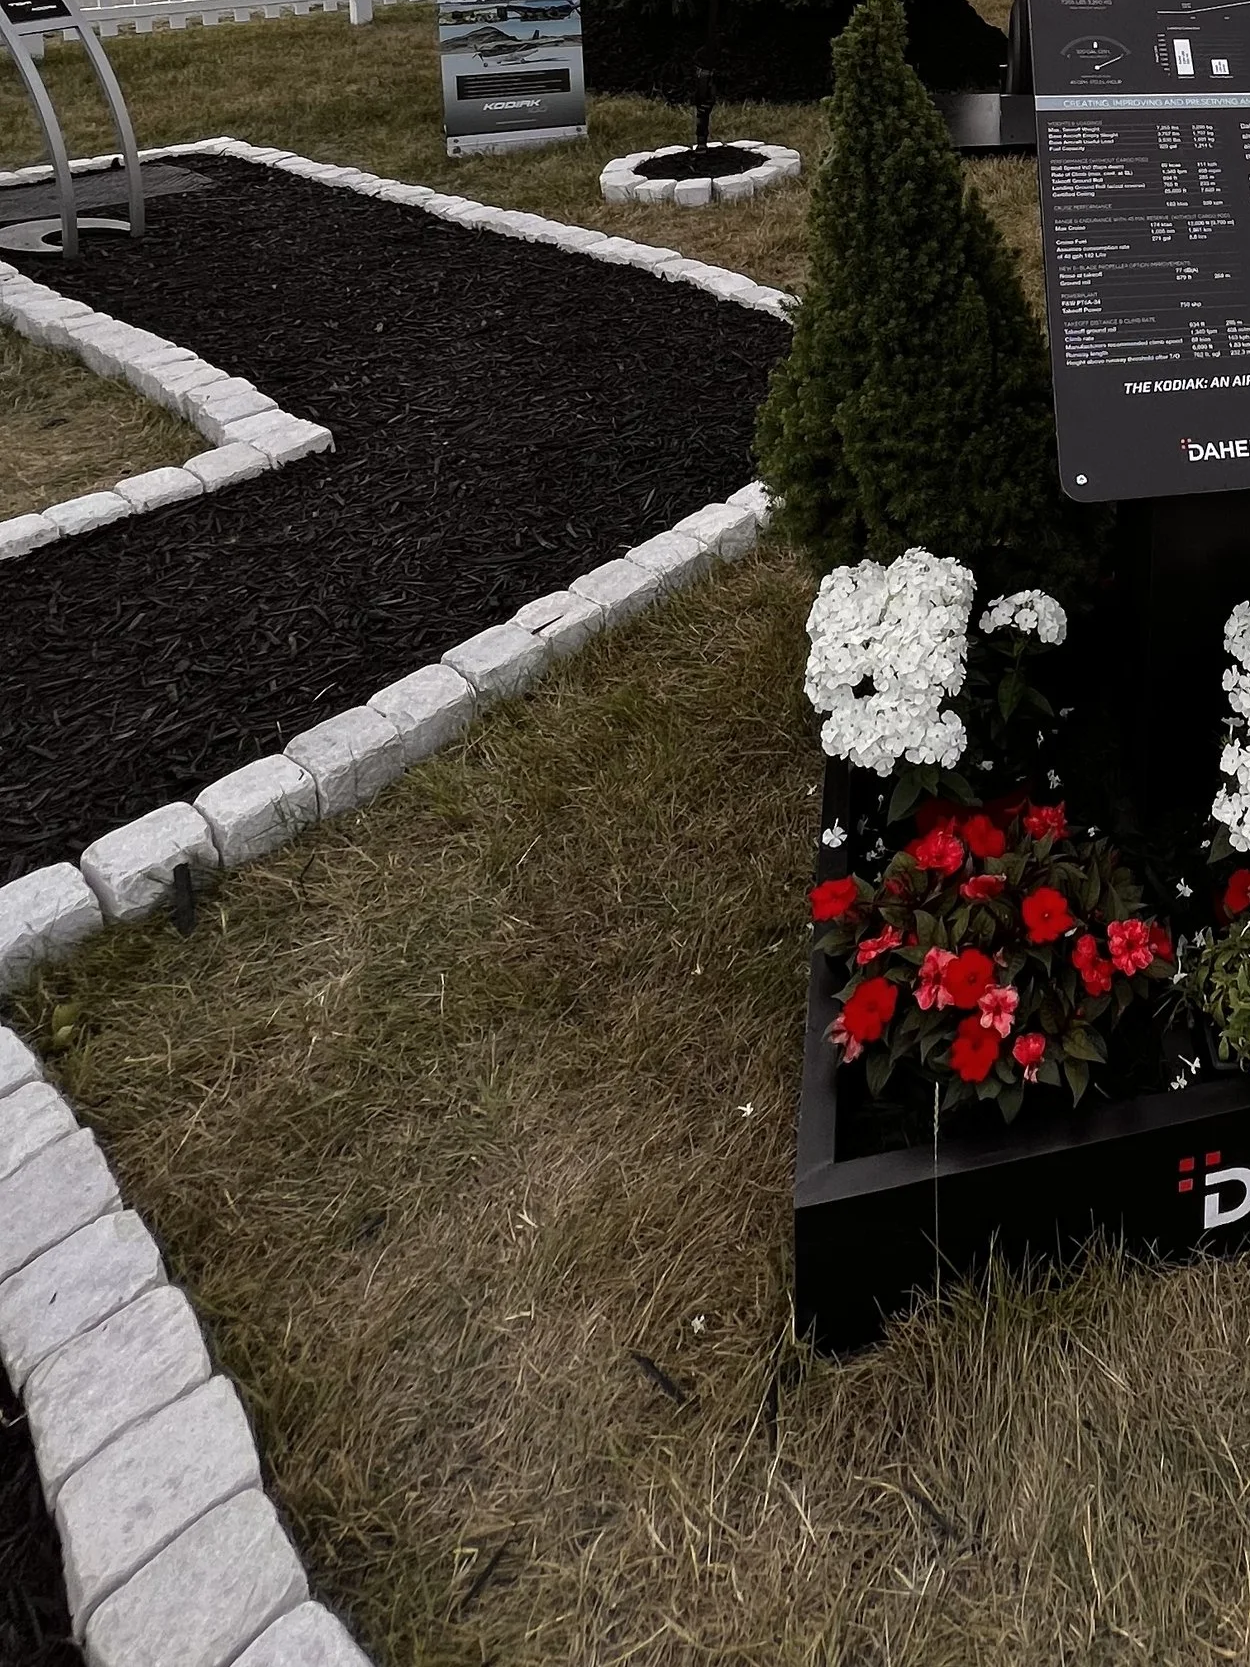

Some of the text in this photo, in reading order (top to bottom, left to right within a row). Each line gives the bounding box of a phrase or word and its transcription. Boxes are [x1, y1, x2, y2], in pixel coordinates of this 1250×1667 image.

[483, 99, 542, 111] KODIAK
[1111, 98, 1163, 107] IMPROVING
[1163, 98, 1184, 106] AND
[1184, 97, 1238, 106] PRESERVING
[1123, 380, 1152, 395] THE
[1152, 376, 1208, 392] KODIAK:
[1209, 375, 1230, 388] AN
